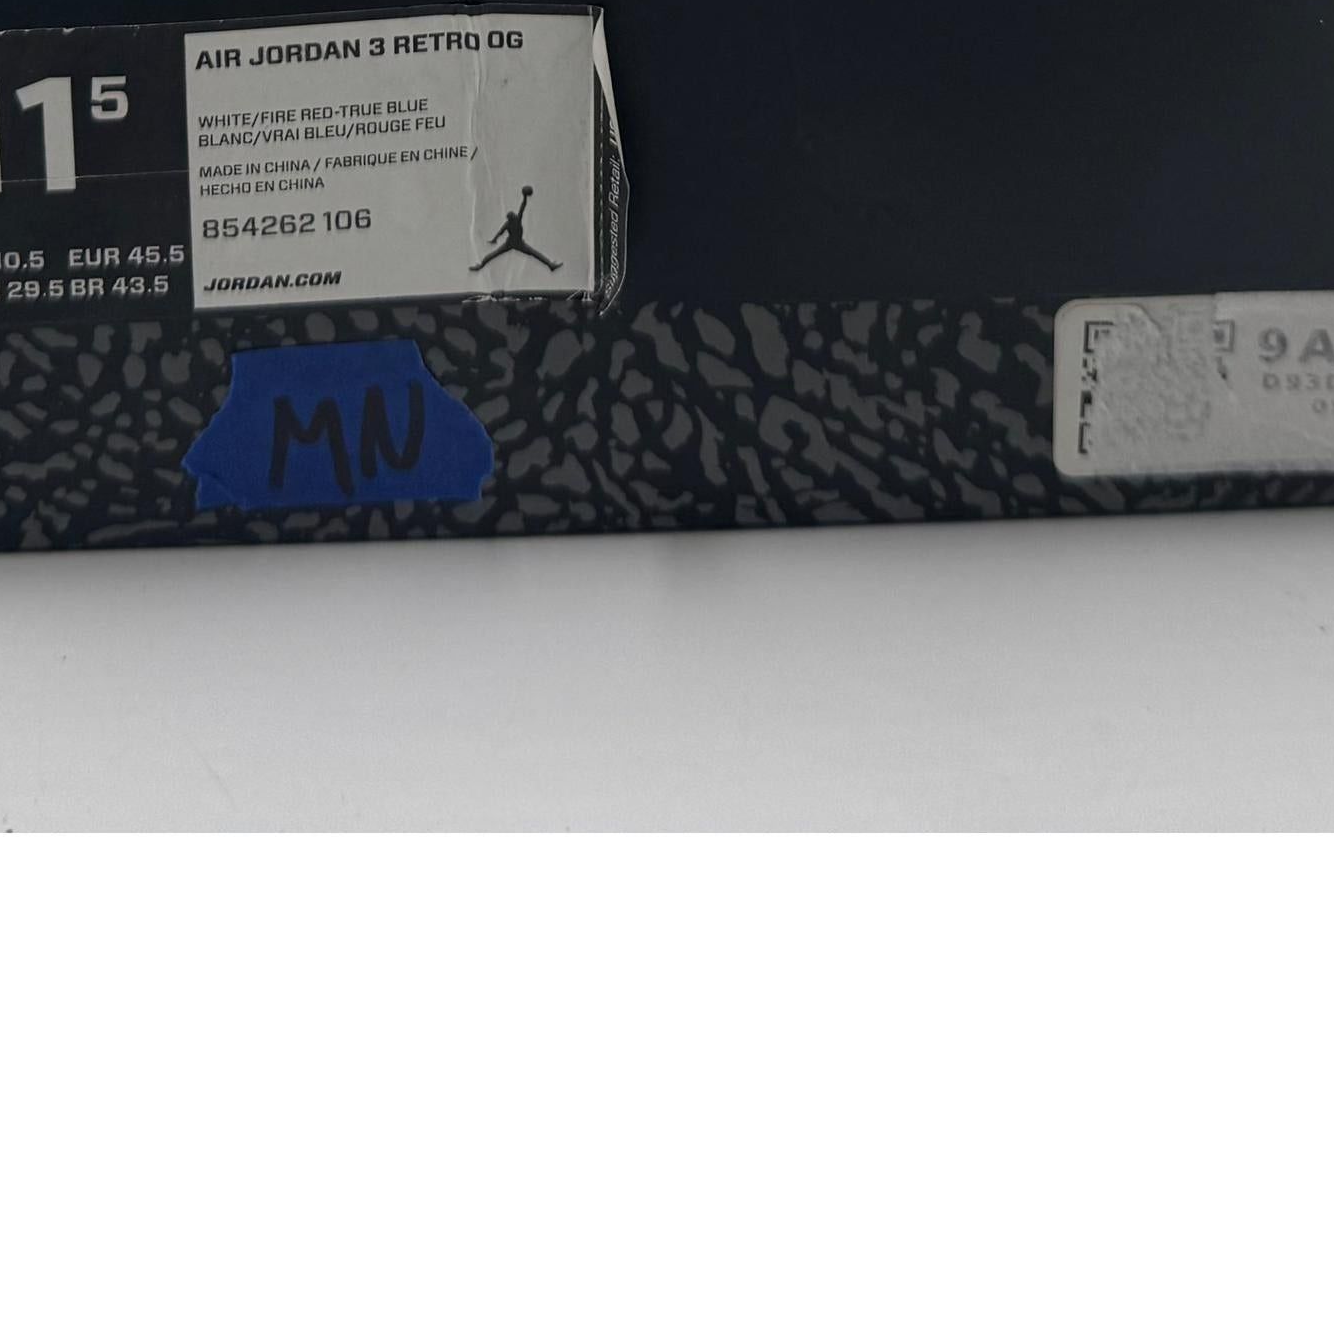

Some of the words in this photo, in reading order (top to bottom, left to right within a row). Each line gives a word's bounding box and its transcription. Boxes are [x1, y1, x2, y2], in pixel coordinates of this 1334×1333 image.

[195, 48, 241, 70] AIR
[249, 39, 361, 67] JORDAN
[369, 36, 385, 56] 3
[393, 31, 481, 55] RETRO
[487, 30, 523, 50] OG
[90, 75, 130, 120] 5
[198, 109, 297, 129] WHITE/FIRE
[300, 102, 382, 122] RED-TRUE
[387, 98, 428, 114] BLUE
[198, 127, 300, 148] BLANC/VRAI
[304, 120, 411, 141] BLEU/ROUGE
[415, 115, 446, 130] FEU
[199, 164, 243, 179] MADE
[245, 162, 262, 176] IN
[264, 159, 311, 174] CHINA
[324, 151, 398, 169] FABRIQUE
[400, 149, 420, 162] EN
[423, 146, 468, 162] CHINE
[200, 181, 252, 198] HECHO
[255, 180, 275, 193] EN
[278, 176, 325, 191] CHINA
[202, 212, 316, 239] 854262
[322, 208, 373, 232] 106
[68, 247, 120, 268] EUR
[128, 244, 185, 265] 45.5
[7, 279, 64, 300] 29.5
[71, 278, 105, 297] BR
[112, 275, 169, 295] 43.5
[203, 270, 342, 292] JORDAN.COM
[270, 383, 425, 496] MN
